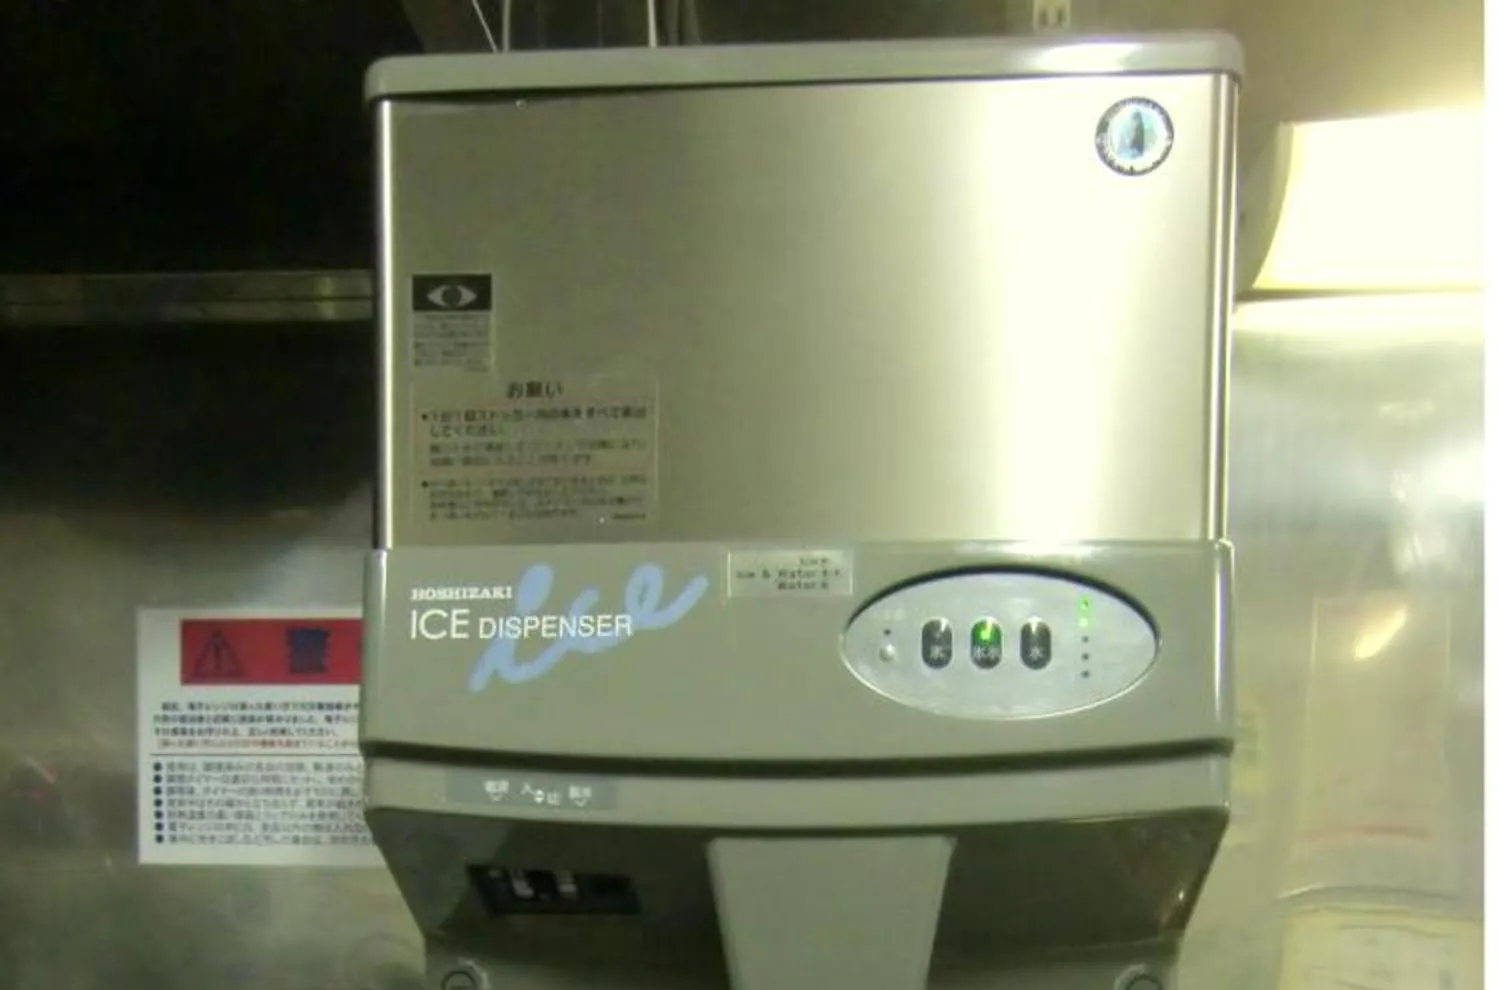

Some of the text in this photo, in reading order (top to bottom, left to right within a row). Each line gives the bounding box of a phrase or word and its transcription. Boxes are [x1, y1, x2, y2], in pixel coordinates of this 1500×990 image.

[411, 586, 512, 600] HOSHIZAKI
[410, 608, 633, 640] ICE DISPENSER
